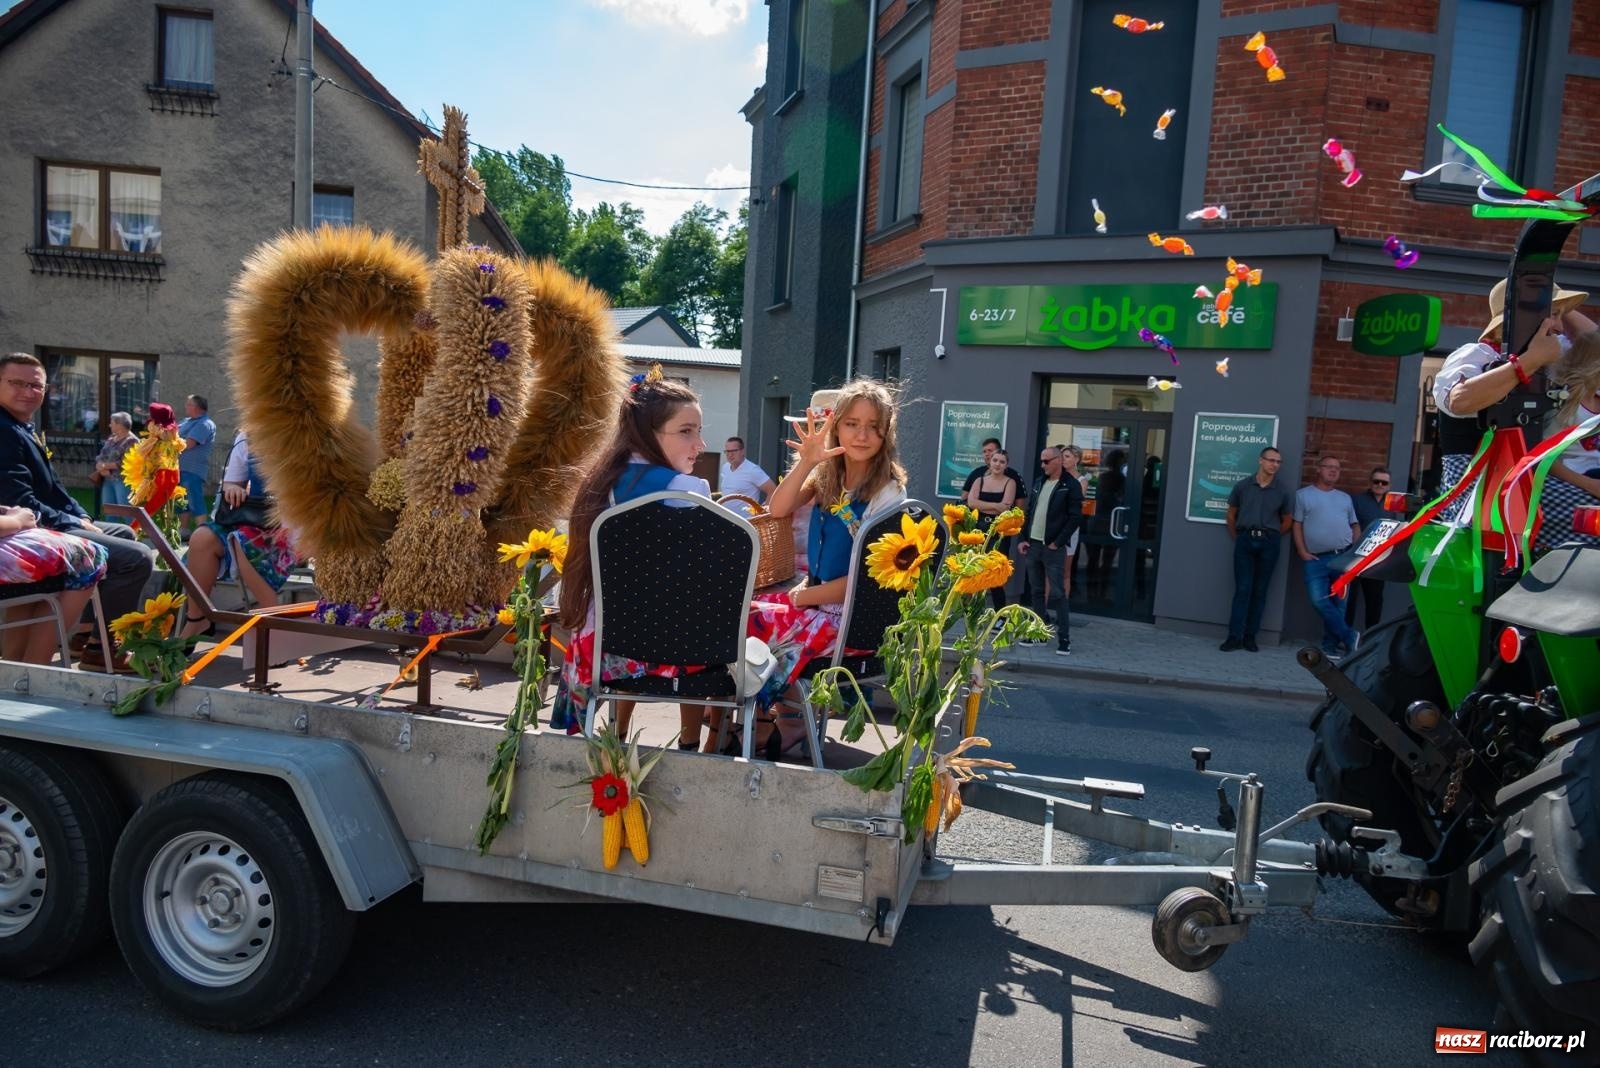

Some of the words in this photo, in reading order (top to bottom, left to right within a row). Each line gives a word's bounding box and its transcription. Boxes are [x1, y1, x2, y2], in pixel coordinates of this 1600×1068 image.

[969, 308, 1016, 321] 6-23/7
[1038, 296, 1176, 333] żabka
[1360, 309, 1422, 335] żabka
[947, 409, 990, 419] Poprowadź
[959, 422, 976, 430] sklep
[976, 421, 1000, 430] ŻABKA
[1201, 421, 1256, 433] Poprowadź
[1215, 434, 1237, 444] sklep
[1238, 434, 1268, 444] ŻABKA
